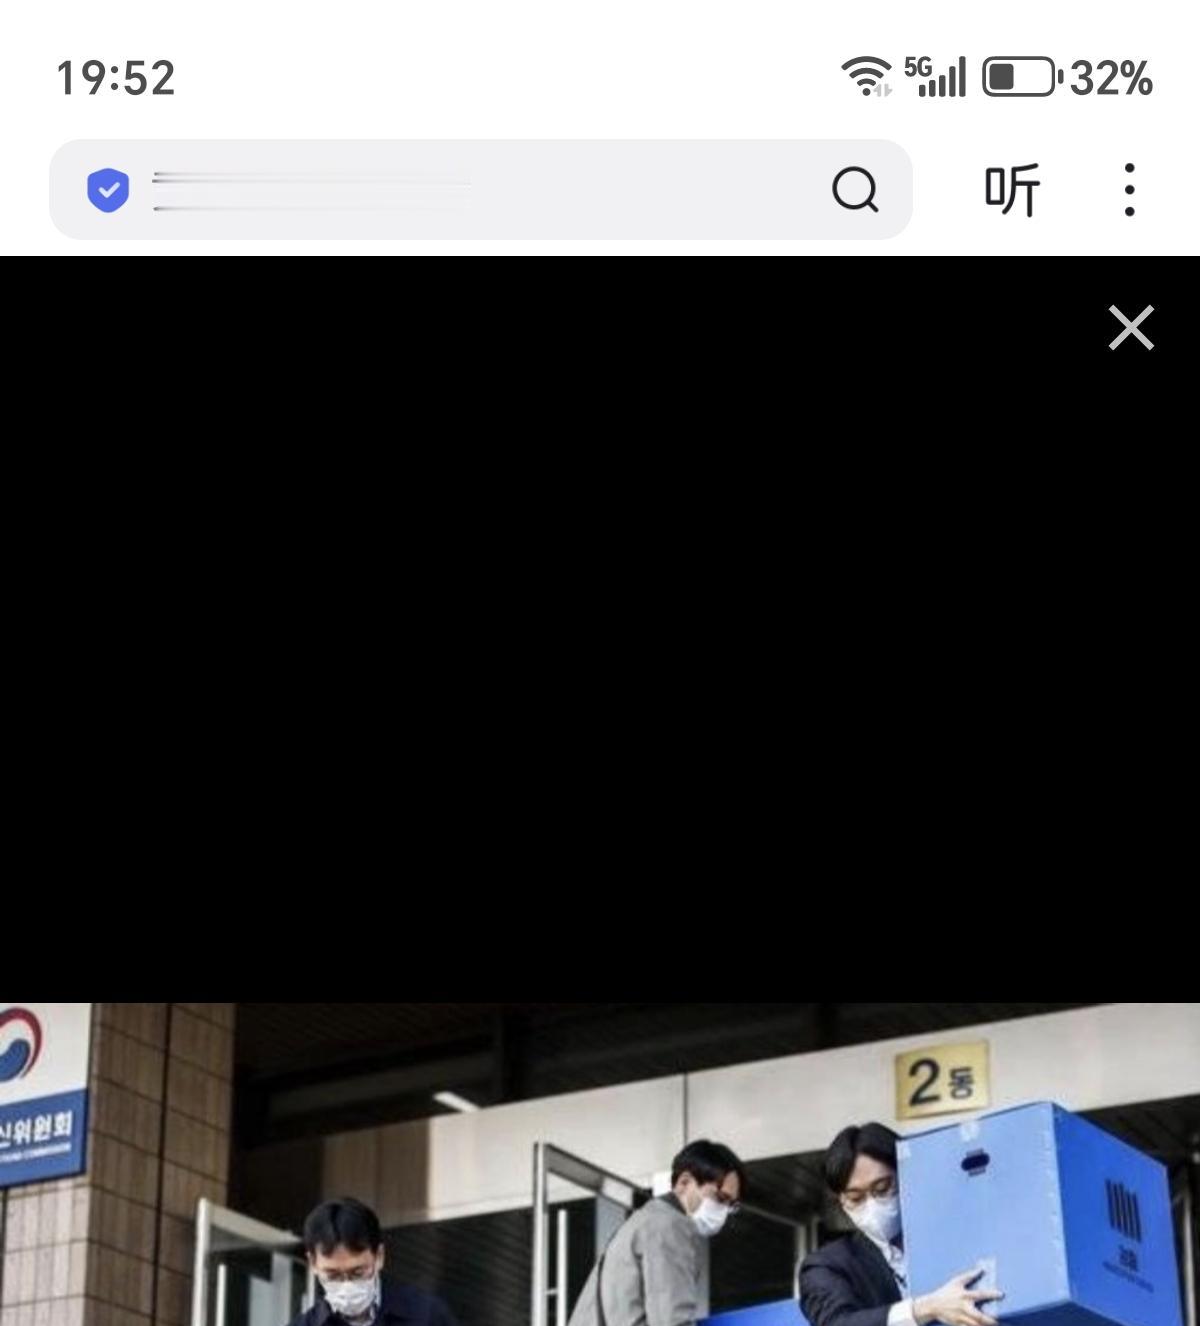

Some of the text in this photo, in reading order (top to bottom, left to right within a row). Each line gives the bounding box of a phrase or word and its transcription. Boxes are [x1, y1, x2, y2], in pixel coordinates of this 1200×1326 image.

[58, 60, 175, 95] 19:52
[904, 55, 933, 77] 5G
[1070, 60, 1153, 96] 32%
[985, 162, 1041, 218] 听
